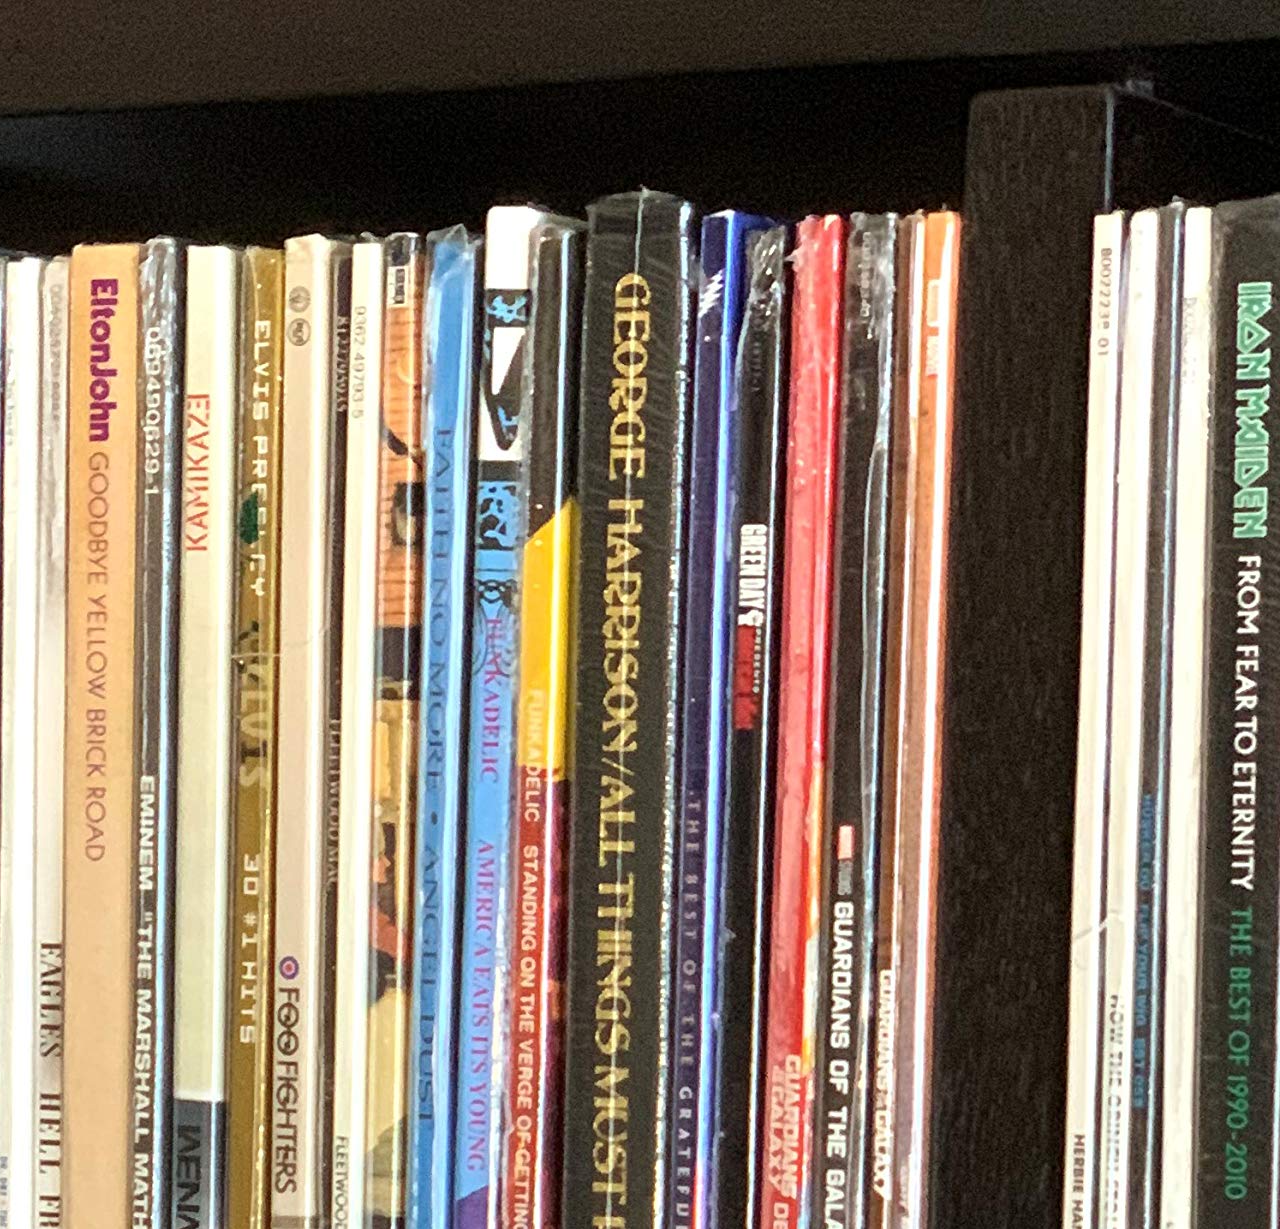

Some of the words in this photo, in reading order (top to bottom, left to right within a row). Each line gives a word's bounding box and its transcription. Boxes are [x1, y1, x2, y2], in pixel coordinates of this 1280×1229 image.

[1236, 282, 1272, 380] IRON
[607, 274, 651, 480] GEORGE
[185, 394, 210, 551] KAMIKAZE
[1233, 384, 1271, 539] MAIDEN
[88, 452, 109, 584] GOODBYE
[740, 525, 767, 576] GREEN
[738, 579, 763, 611] DAY
[1236, 555, 1261, 634] FROM
[86, 595, 107, 699] YELLOW
[1234, 644, 1259, 711] FEAR
[481, 618, 503, 784] FUNKADELIC
[1233, 716, 1257, 755] TO
[85, 710, 107, 777] BRICK
[525, 690, 542, 822] FUNKADELIC
[85, 787, 106, 861] ROAD
[1231, 762, 1256, 890] ETERNITY
[475, 841, 497, 956] AMERICA
[521, 845, 539, 950] STANDING
[1230, 906, 1253, 956] THE
[40, 942, 61, 1058] EAGLES
[472, 968, 491, 1028] EATS
[521, 957, 537, 987] ON
[593, 873, 634, 1054] THINGS
[831, 902, 853, 1049] GUARDIANS
[1228, 967, 1252, 1021] BEST
[276, 988, 299, 1056] FOO
[519, 995, 535, 1032] THE
[1227, 1031, 1250, 1067] OF
[470, 1036, 489, 1073] ITS
[516, 1040, 534, 1108] VERGE
[829, 1060, 849, 1093] OF
[38, 1093, 60, 1175] HELL
[275, 1061, 298, 1194] FIGHTERS
[467, 1079, 488, 1171] YOUNG
[515, 1116, 532, 1140] OF
[590, 1066, 629, 1206] MUST
[780, 1054, 801, 1200] GUARDIANS
[827, 1109, 847, 1158] THE
[1073, 1135, 1085, 1193] HERBIE
[1225, 1075, 1249, 1200] 1990-2010
